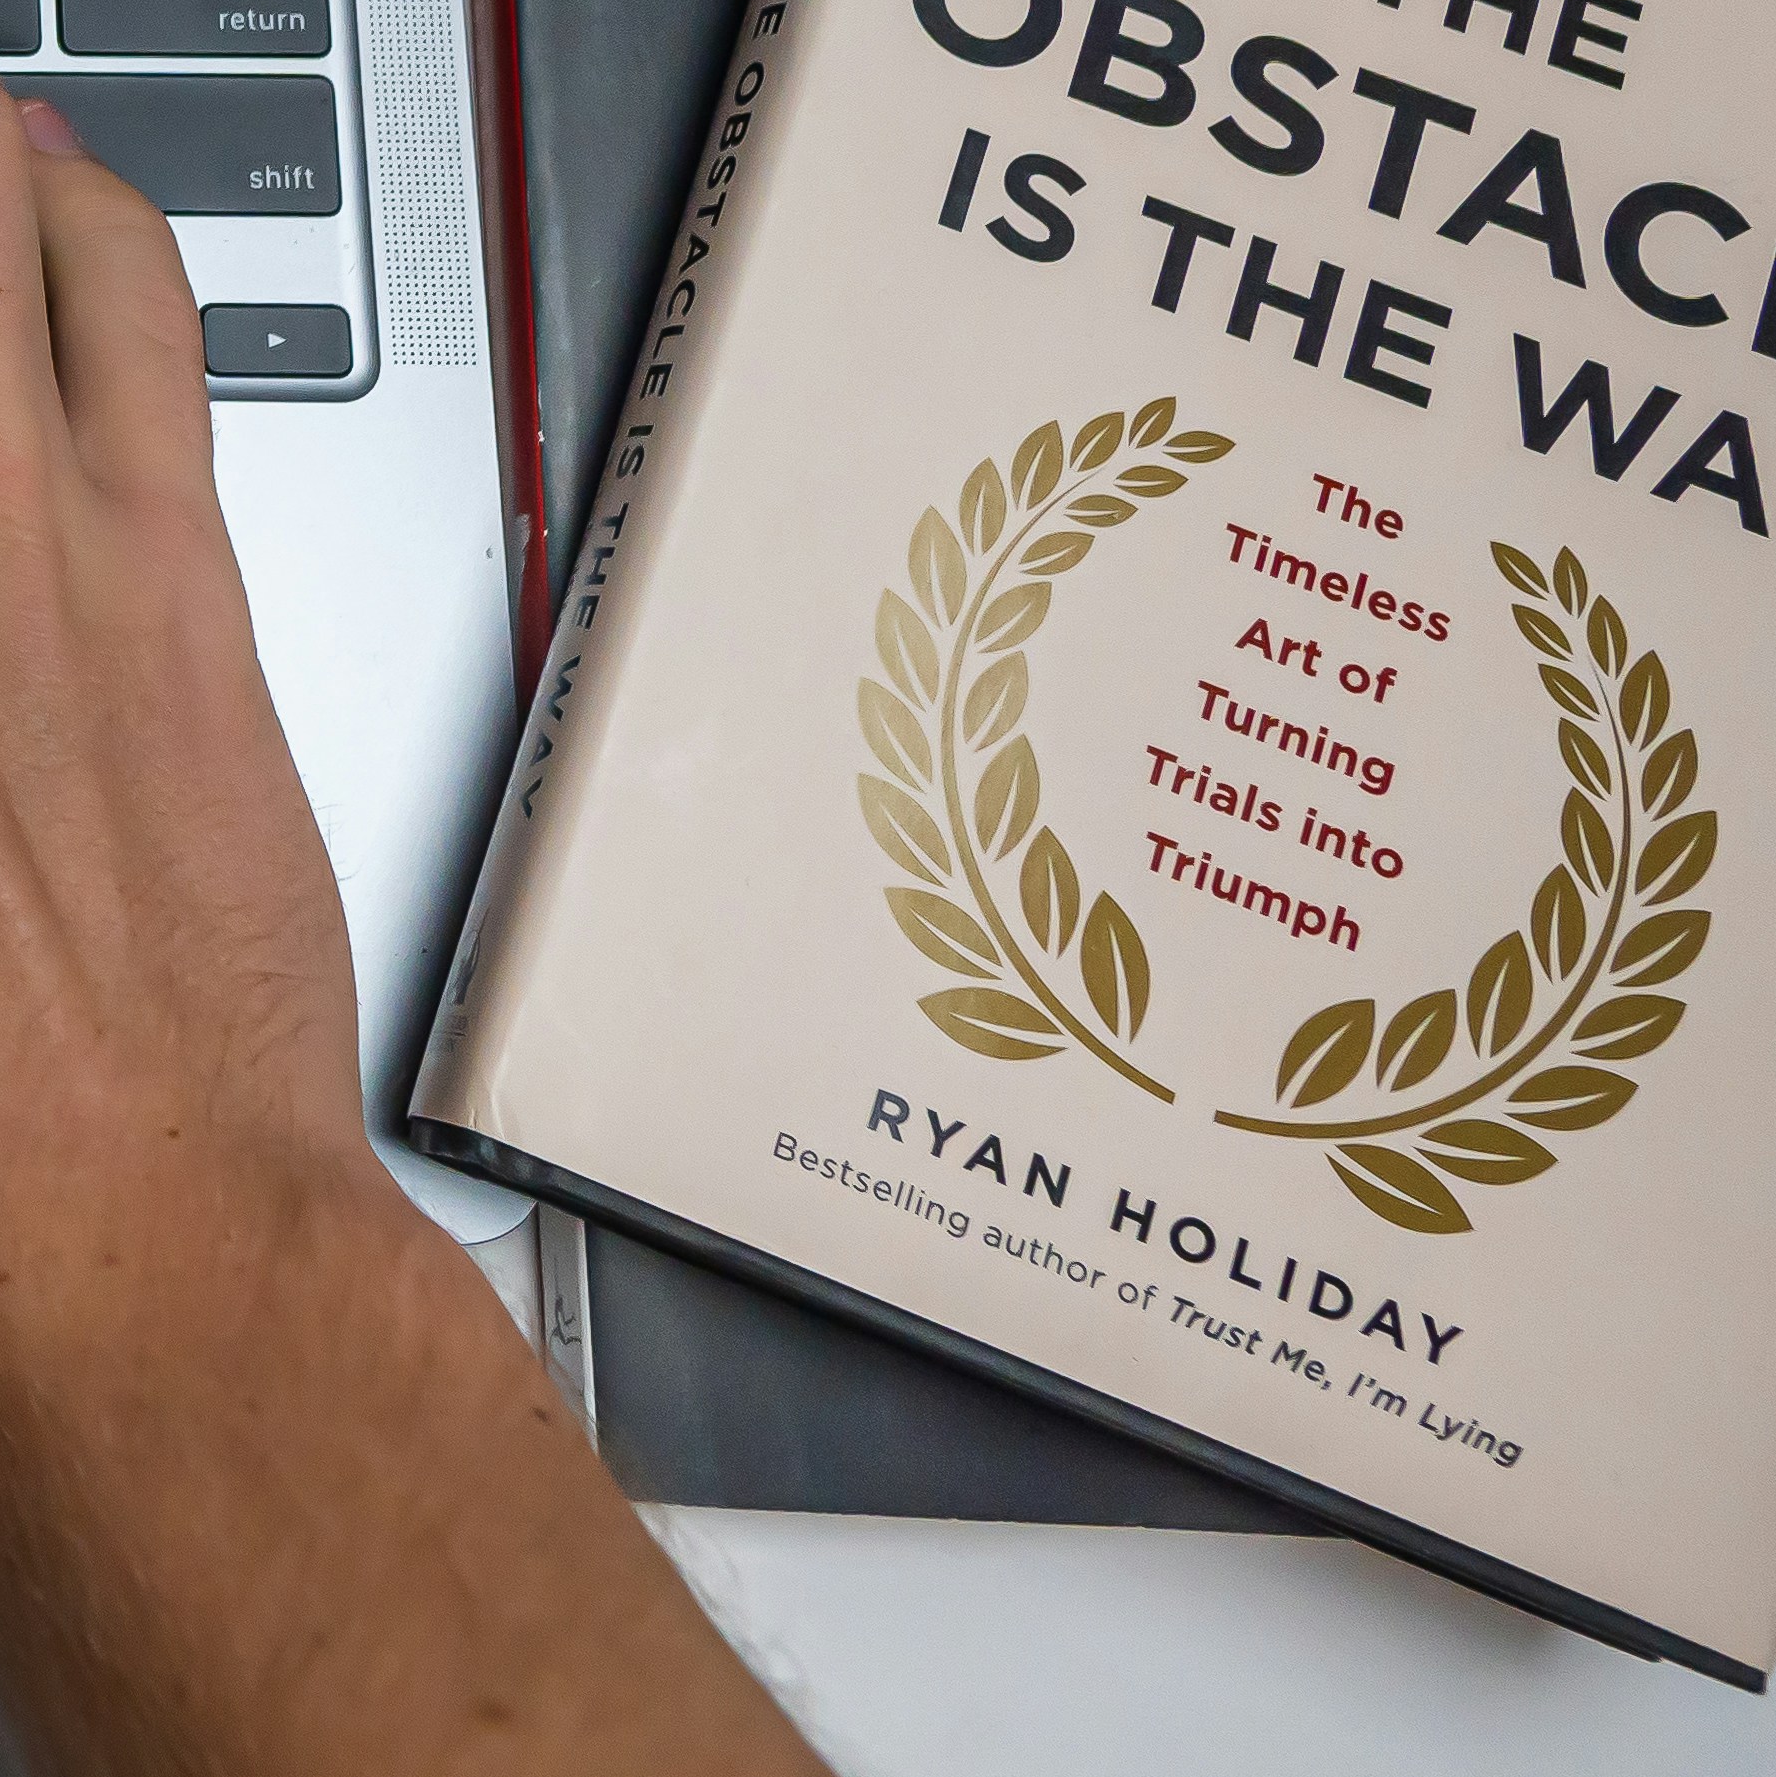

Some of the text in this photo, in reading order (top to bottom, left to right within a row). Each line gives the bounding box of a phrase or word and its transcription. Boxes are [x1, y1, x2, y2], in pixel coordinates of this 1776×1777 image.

[219, 8, 306, 32] return
[249, 164, 315, 190] shift
[639, 61, 766, 401] OBSTACLE
[937, 127, 1087, 263] IS
[1141, 194, 1453, 410] THE
[616, 423, 655, 480] IS
[1312, 472, 1404, 540] The
[576, 501, 630, 632] THE
[1226, 522, 1451, 642] Timeless
[1234, 617, 1398, 704] Art of
[1197, 679, 1396, 796] Turning
[1146, 744, 1404, 879] Trials into
[1146, 831, 1360, 952] Triumph
[866, 1088, 1464, 1365] RYAN HOLIDAY
[773, 1130, 970, 1239] Bestselling
[982, 1225, 1107, 1289] author
[1117, 1282, 1160, 1311] of
[1170, 1295, 1263, 1356] Trust
[1270, 1340, 1332, 1391] Me,
[1417, 1402, 1524, 1469] Lying
